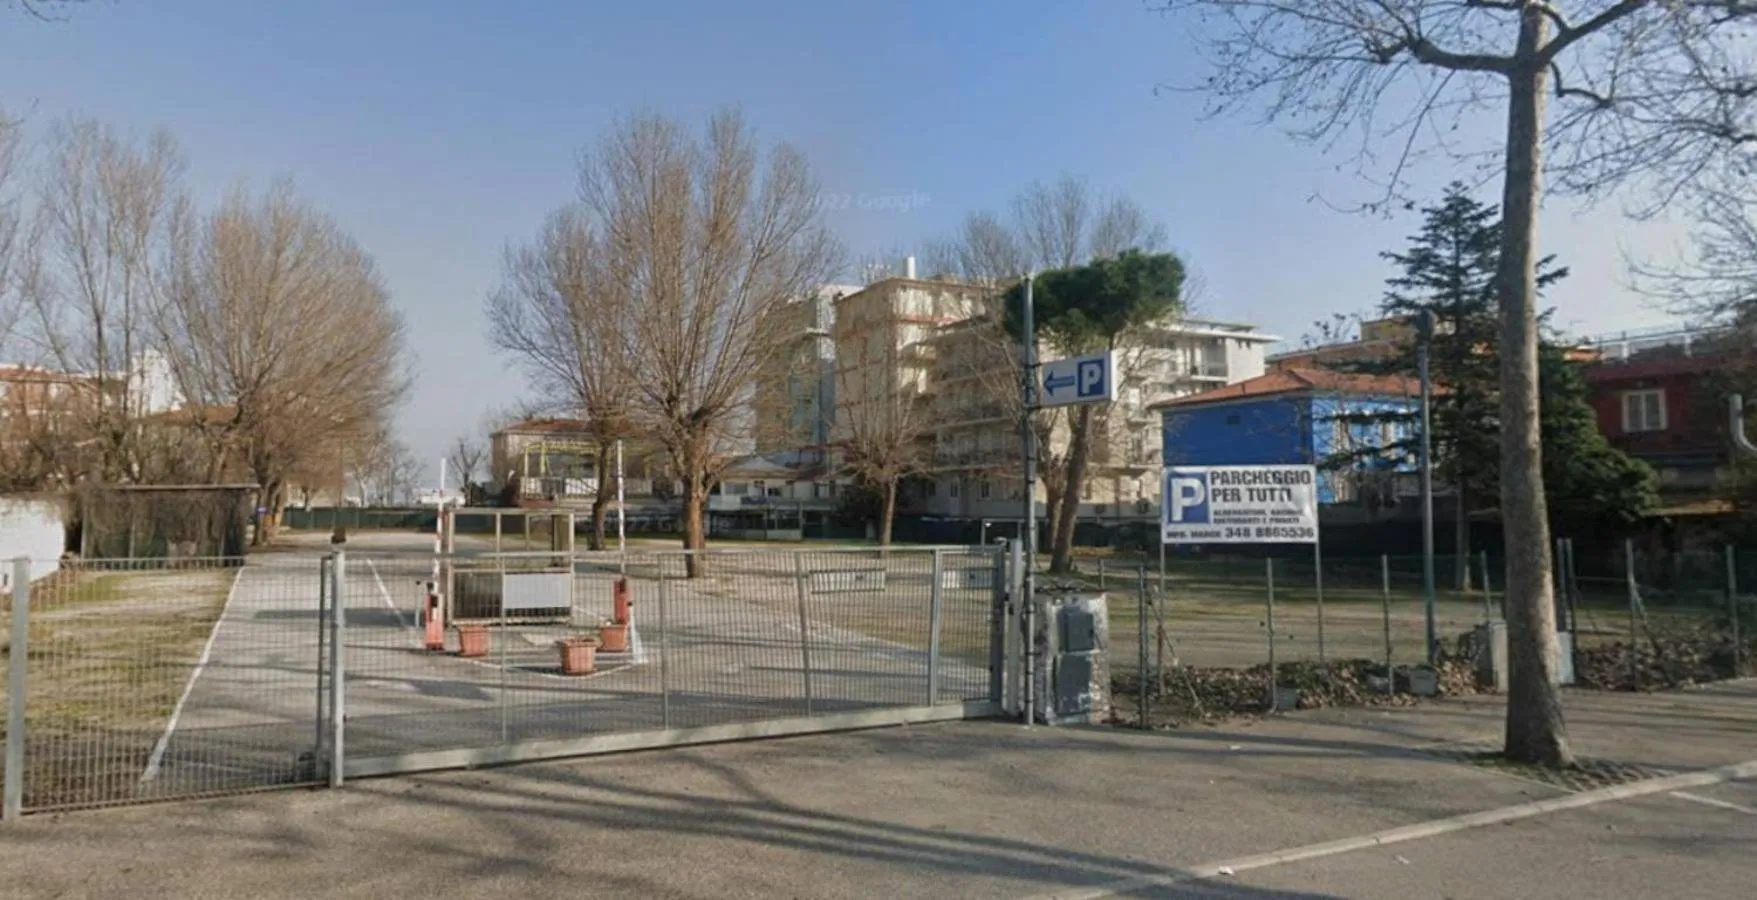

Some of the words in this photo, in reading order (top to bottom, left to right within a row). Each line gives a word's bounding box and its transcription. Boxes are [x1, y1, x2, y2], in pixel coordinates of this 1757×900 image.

[1082, 363, 1102, 394] P
[1211, 470, 1311, 485] PARCHEGGIO
[1171, 478, 1205, 521] P
[1212, 488, 1241, 502] PER
[1247, 488, 1292, 502] TUTTI
[1225, 527, 1250, 538] 348
